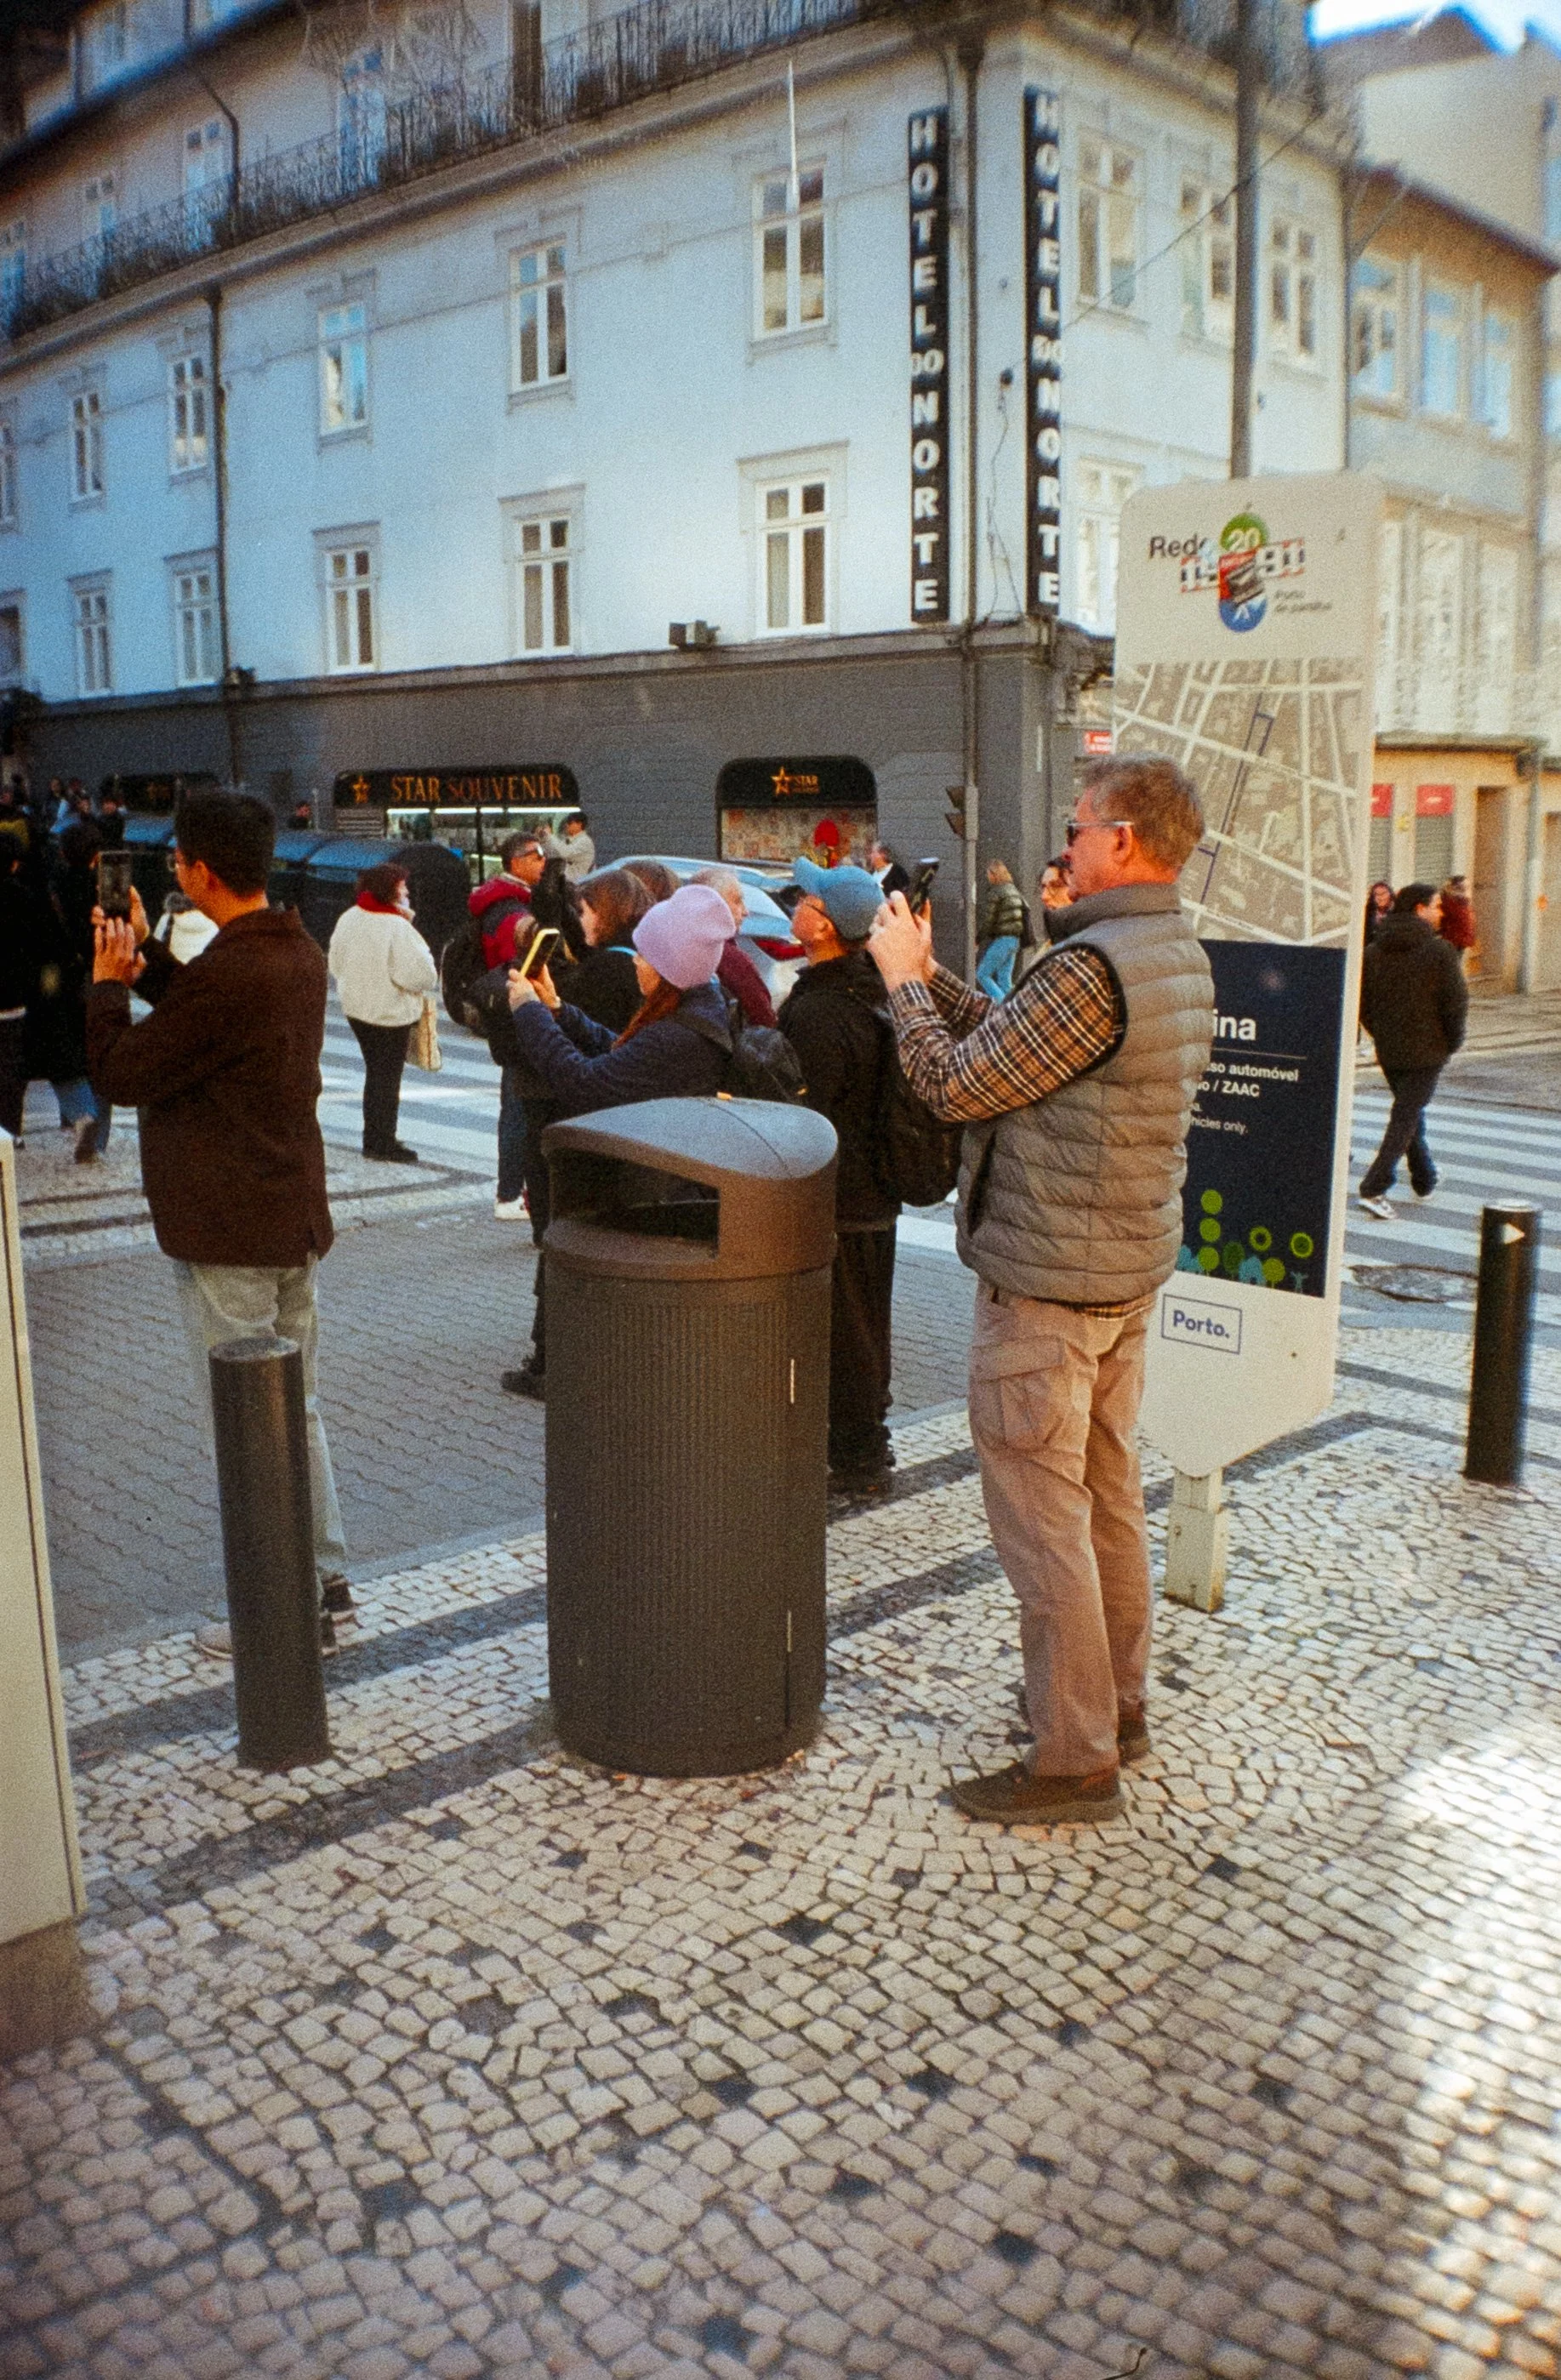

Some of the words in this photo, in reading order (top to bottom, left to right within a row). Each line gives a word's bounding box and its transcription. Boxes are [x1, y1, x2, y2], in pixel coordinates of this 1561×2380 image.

[911, 114, 938, 335] HOTEL
[1034, 90, 1060, 328] HOTEL
[912, 391, 940, 612] NORTE
[1036, 377, 1061, 605] NORTE
[390, 775, 441, 802] STAR
[446, 773, 562, 802] SOUVENIR
[1213, 1009, 1256, 1041] ina
[1229, 1064, 1299, 1081] automóvel
[1222, 1081, 1260, 1097] ZAAC
[1173, 1310, 1230, 1338] Porto.
